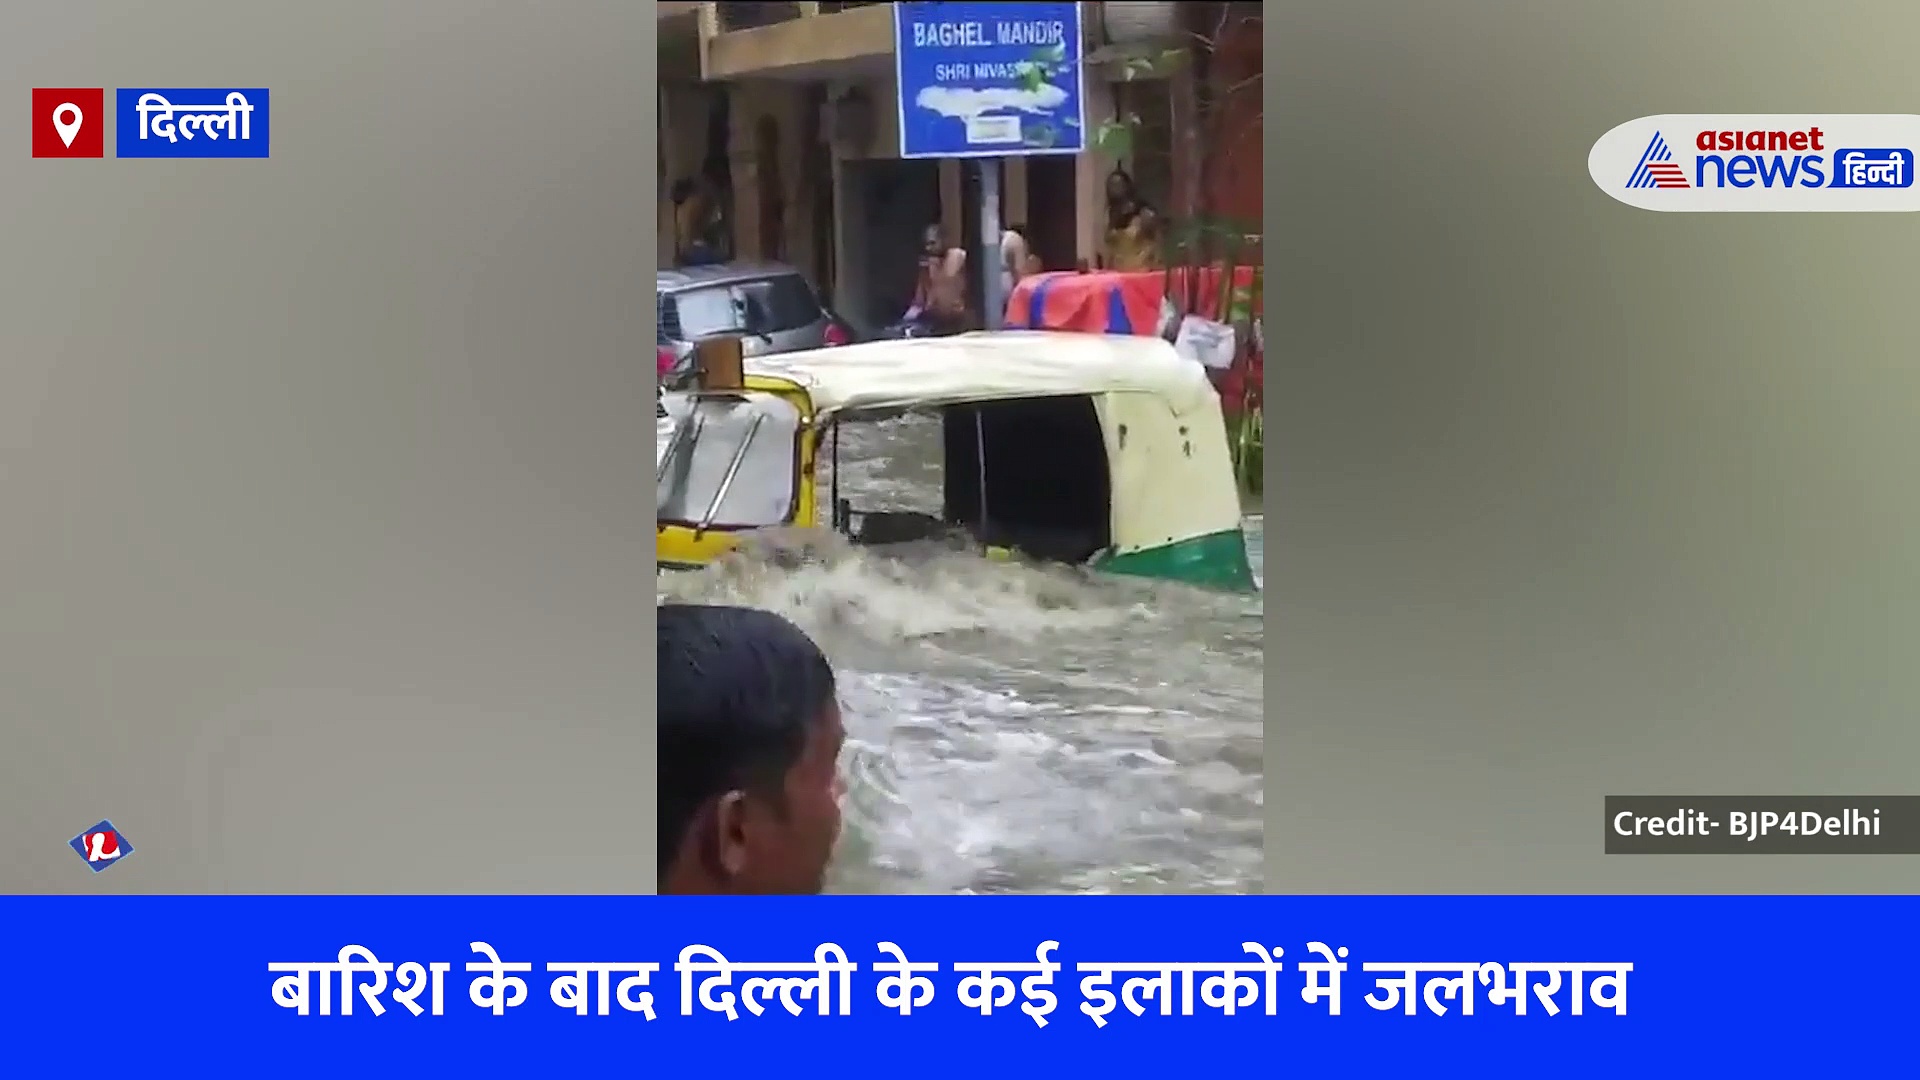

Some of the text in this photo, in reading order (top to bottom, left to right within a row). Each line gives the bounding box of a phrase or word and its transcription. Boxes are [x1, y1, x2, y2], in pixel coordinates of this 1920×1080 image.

[913, 20, 1065, 47] BAGHEL MANDIR
[935, 62, 970, 82] SHRI
